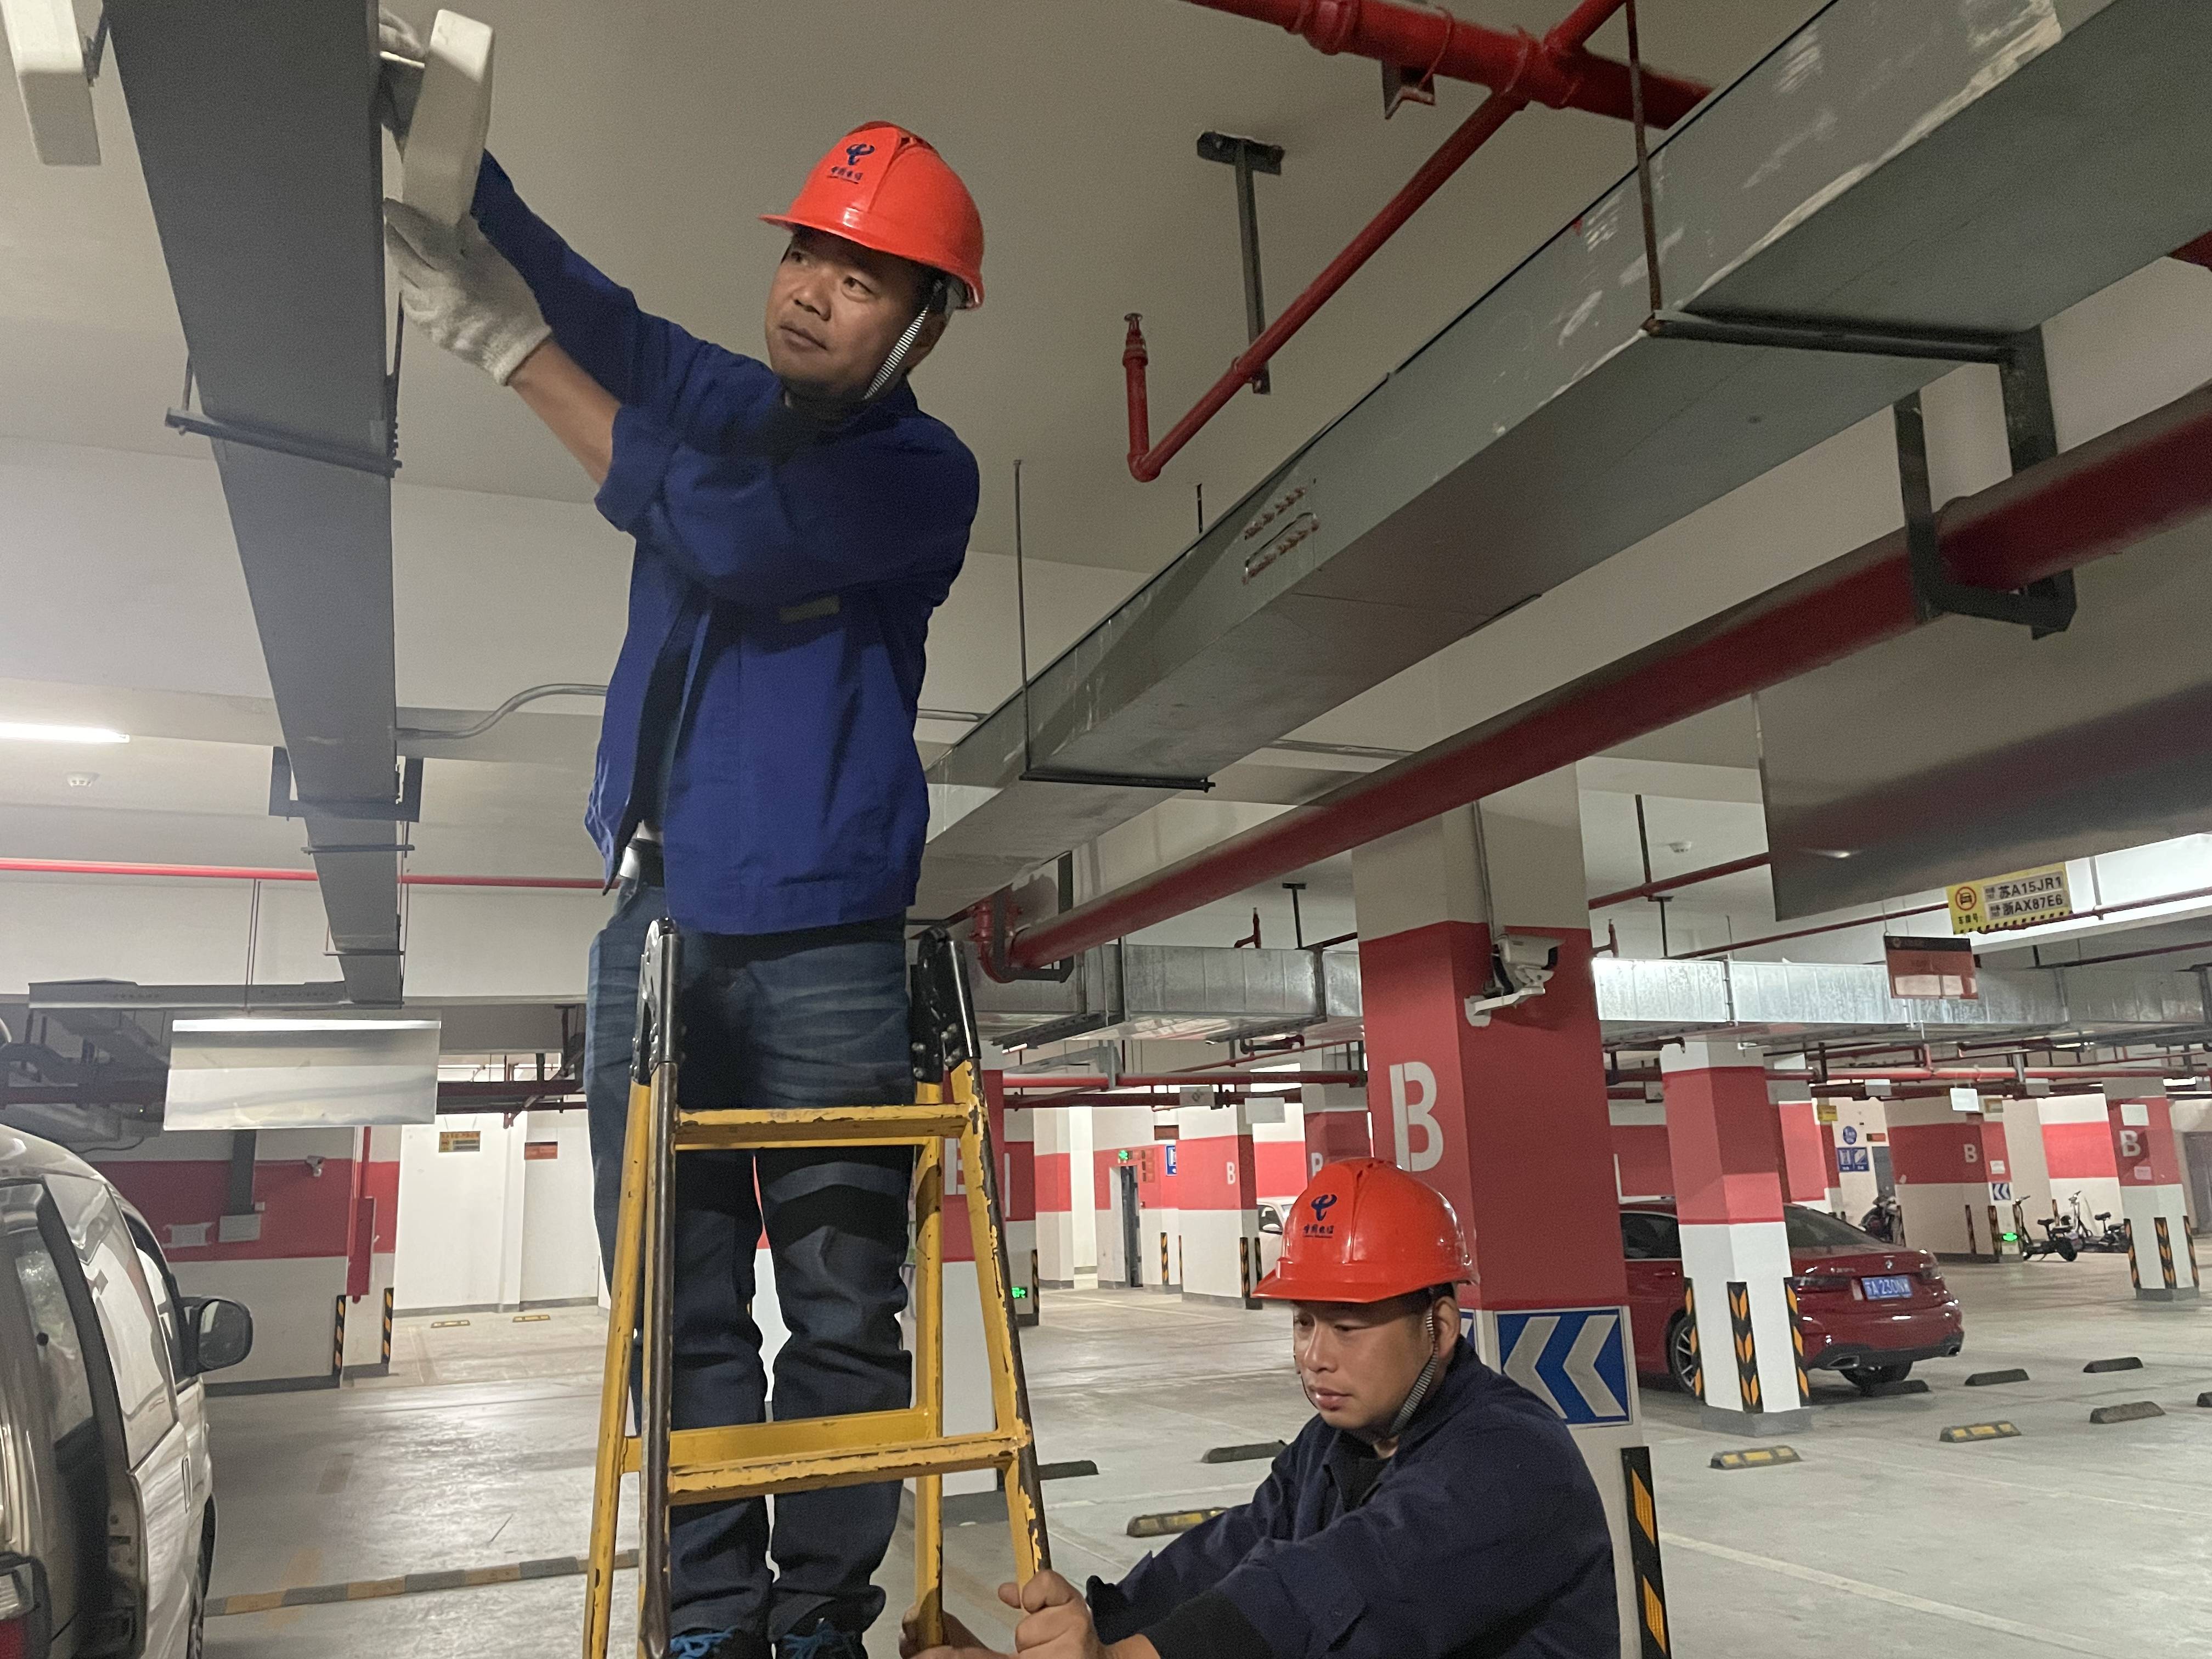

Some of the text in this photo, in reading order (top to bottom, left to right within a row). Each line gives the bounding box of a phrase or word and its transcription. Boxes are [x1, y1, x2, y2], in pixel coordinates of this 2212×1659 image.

[1389, 1062, 1443, 1172] B
[1964, 1144, 1978, 1163] B
[2119, 1130, 2141, 1157] B
[1226, 1161, 1235, 1184] B
